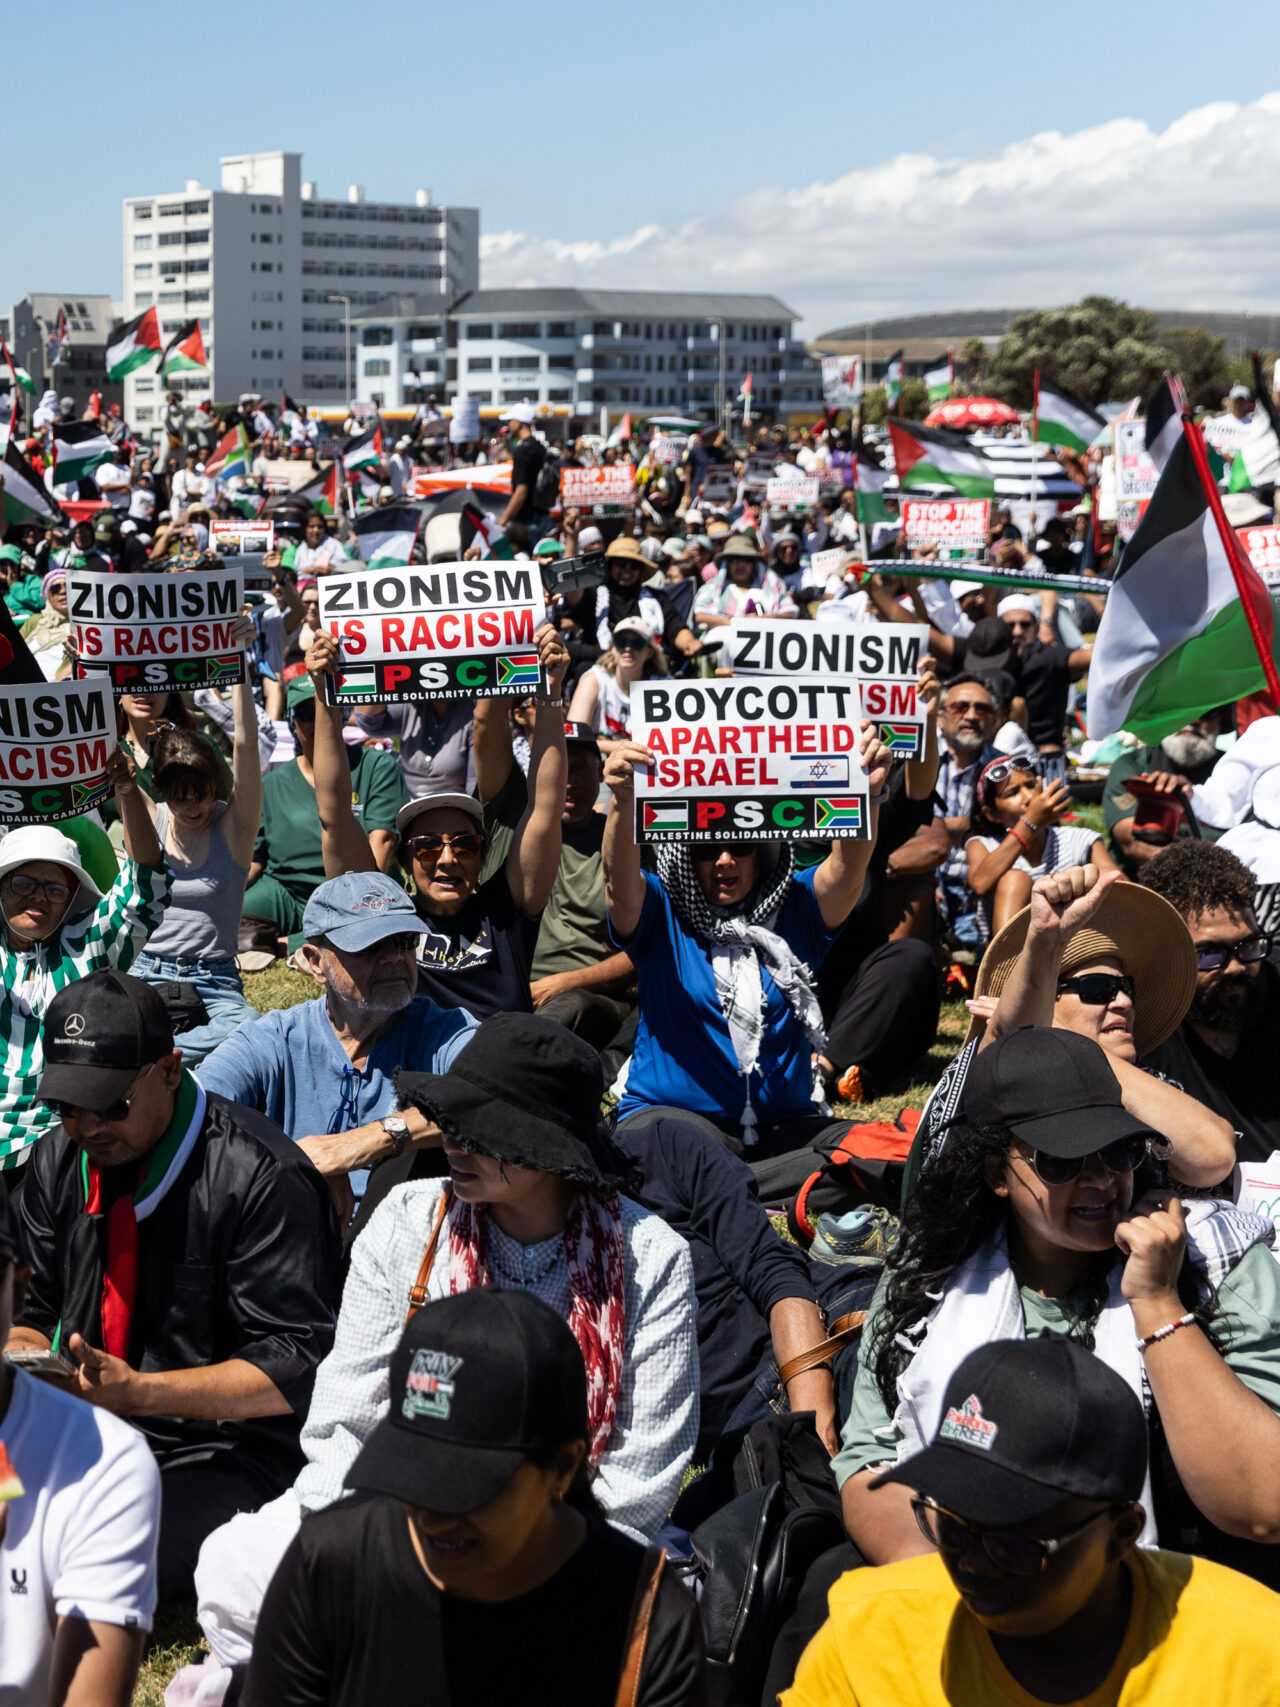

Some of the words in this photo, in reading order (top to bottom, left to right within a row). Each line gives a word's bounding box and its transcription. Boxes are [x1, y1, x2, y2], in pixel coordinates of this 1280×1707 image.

[564, 467, 600, 483] STOP
[602, 466, 631, 481] THE
[908, 503, 952, 520] STOP
[954, 501, 985, 519] THE
[71, 579, 237, 620] ZIONISM
[324, 570, 533, 612] ZIONISM
[76, 625, 103, 656] IS
[114, 621, 237, 657] RACISM
[330, 619, 367, 656] IS
[381, 609, 534, 653] RACISM
[734, 630, 921, 676] ZIONISM
[130, 683, 187, 693] SOLIDARITY
[190, 677, 238, 689] CAMPAIGN
[336, 692, 399, 704] PALESTINE
[402, 689, 471, 701] SOLIDARITY
[476, 685, 537, 696] CAMPAIGN
[643, 685, 851, 723] BOYCOTT
[647, 724, 854, 755] APARTHEID
[647, 757, 779, 788] ISRAEL
[52, 795, 108, 820] CAMPAIGN
[645, 831, 712, 841] PALESTINE
[715, 830, 789, 840] SOLIDARITY
[792, 828, 858, 839] CAMPAIGN
[53, 1038, 96, 1047] Mercedes-Benz
